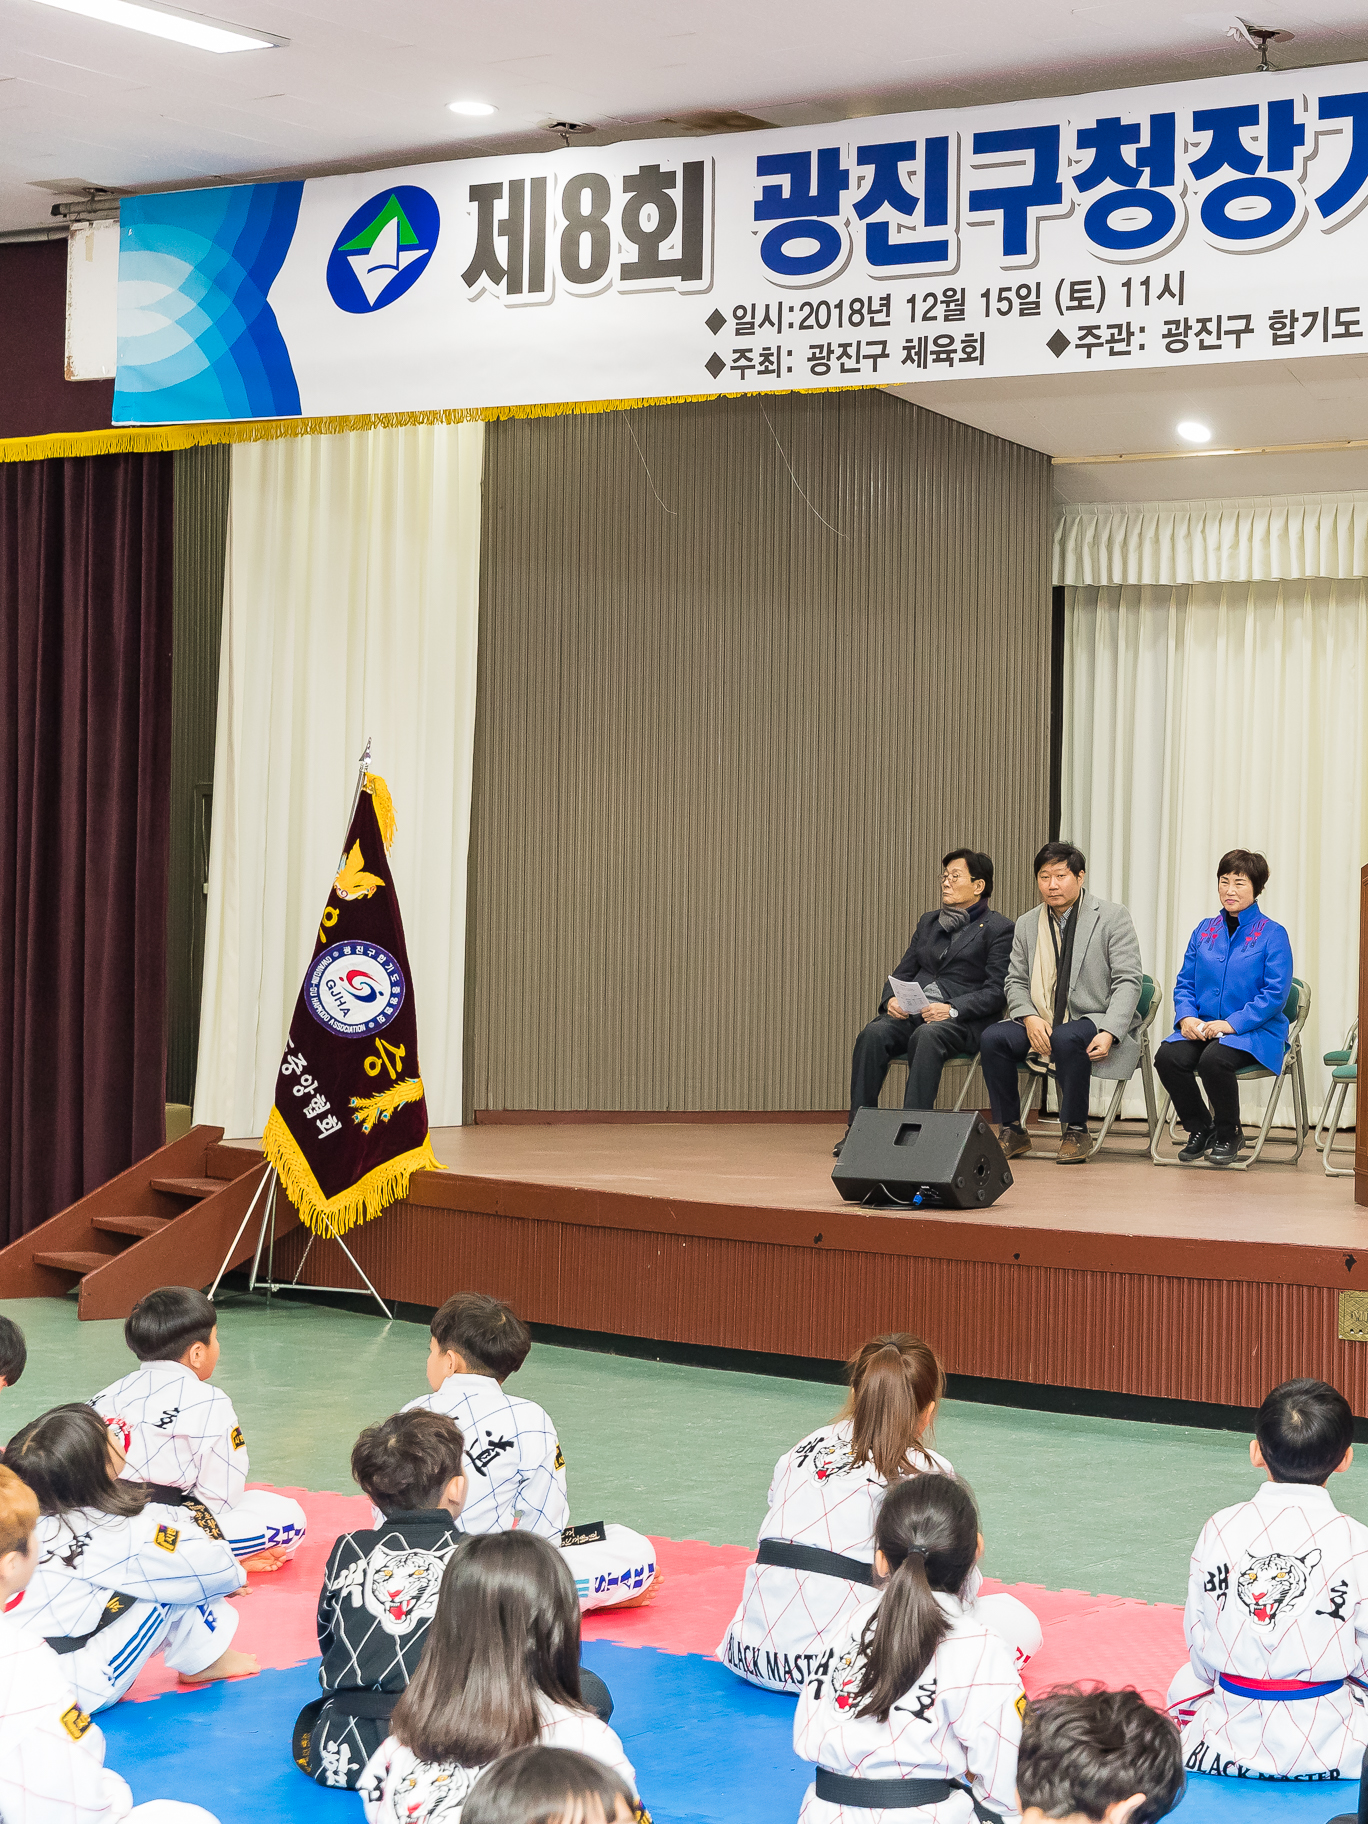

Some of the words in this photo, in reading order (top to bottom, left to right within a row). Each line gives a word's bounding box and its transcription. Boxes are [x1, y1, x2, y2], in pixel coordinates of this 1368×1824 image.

[461, 160, 705, 296] 제8회
[906, 287, 966, 323] 12월
[980, 281, 1042, 318] 15일
[1054, 275, 1106, 316] (토)
[1121, 270, 1186, 308] 11시
[730, 344, 793, 380] 주최:
[806, 339, 890, 376] 광진구
[901, 331, 986, 370] 체육회
[1074, 321, 1147, 359] 주관:
[1161, 313, 1255, 354] 광진구
[1268, 306, 1364, 347] 합기도
[325, 979, 352, 1018] GJHA
[328, 1018, 367, 1034] ASSOCIATION
[281, 1052, 342, 1140] 중앙협회
[1185, 1740, 1252, 1778] BLACK
